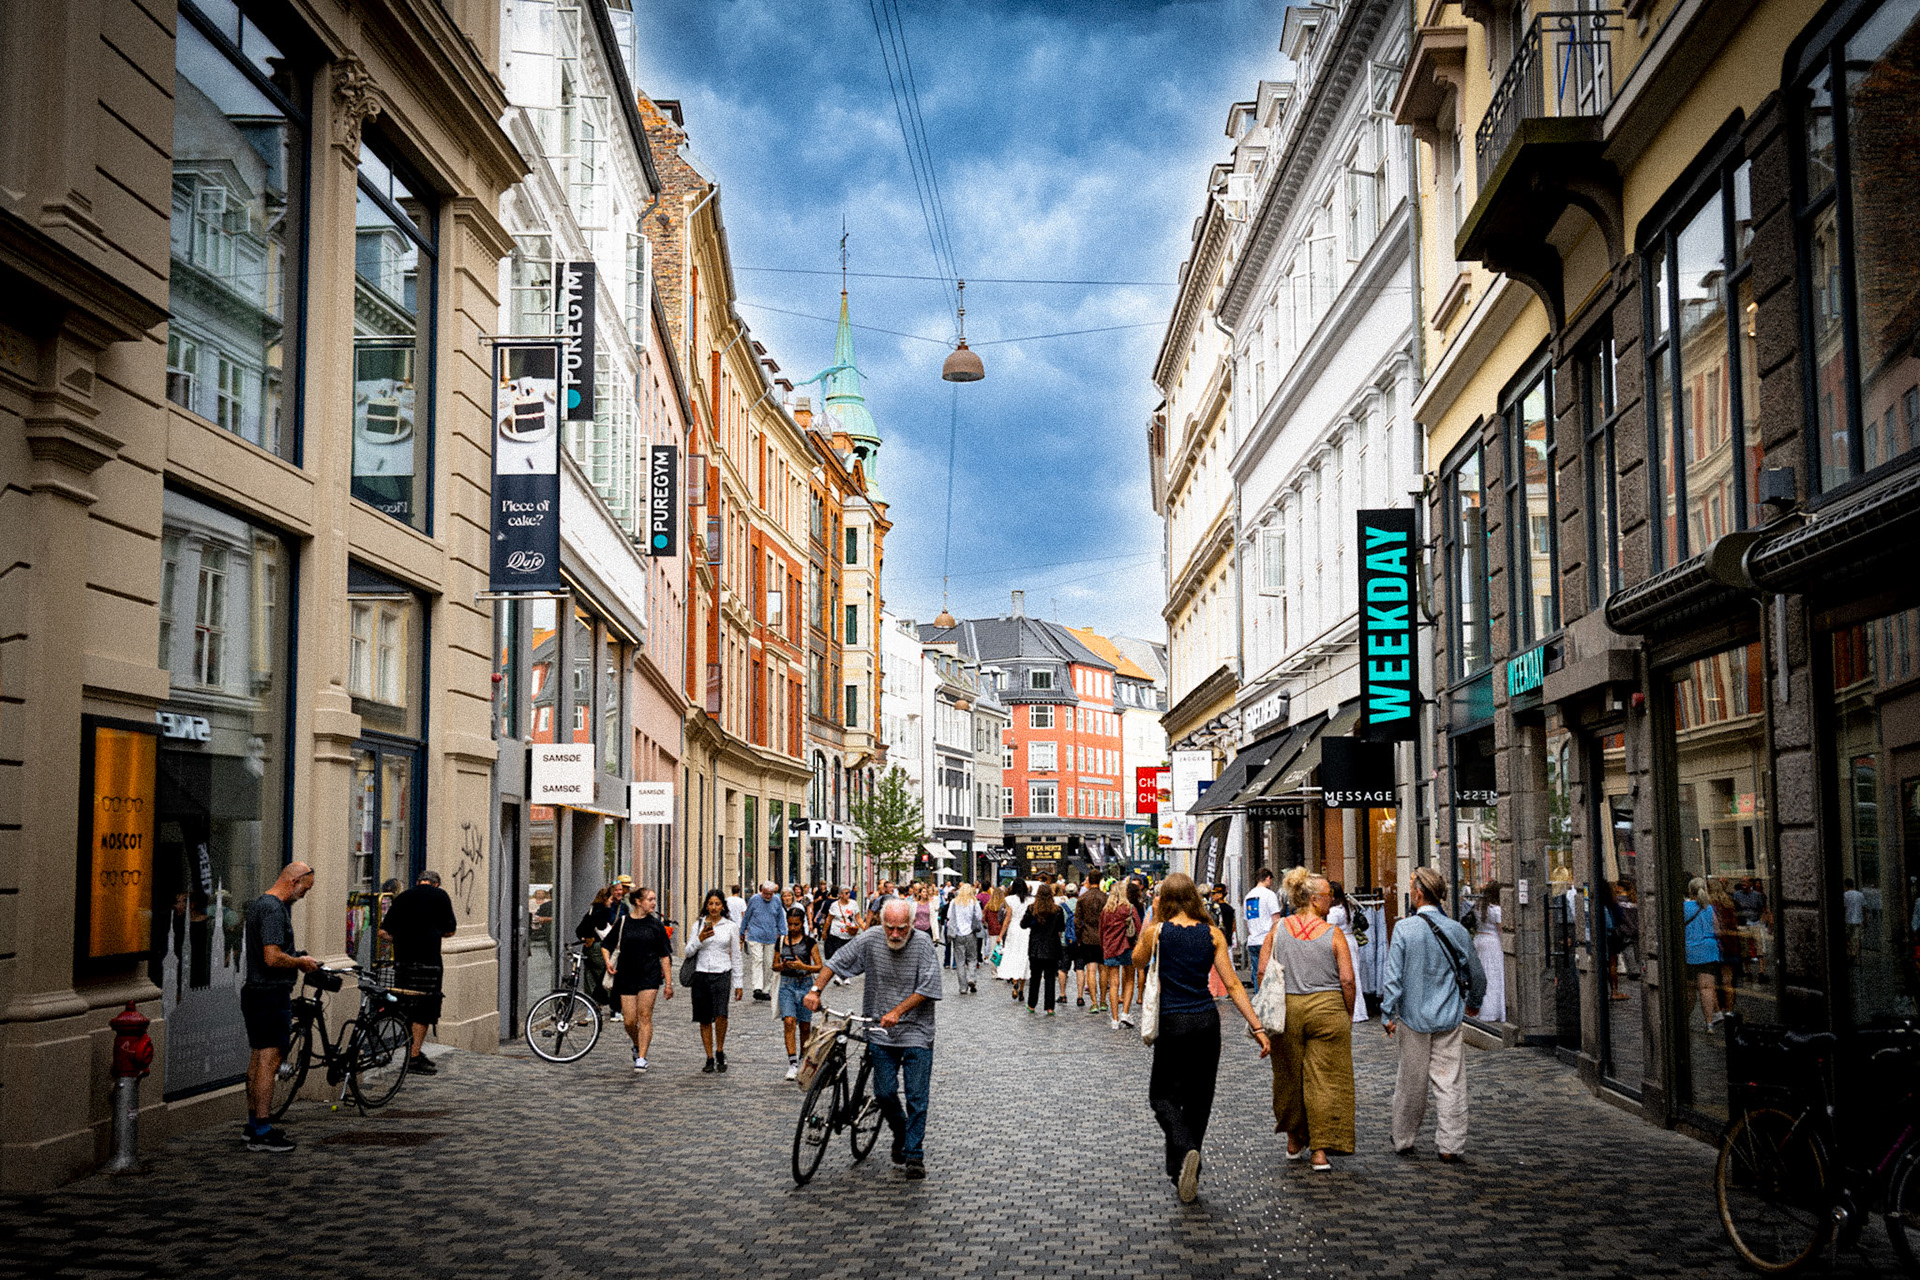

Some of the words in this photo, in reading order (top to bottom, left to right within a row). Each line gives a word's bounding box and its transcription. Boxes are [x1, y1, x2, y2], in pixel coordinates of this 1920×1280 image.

[565, 270, 583, 385] PUREGYM
[653, 452, 669, 532] PUREGYM
[502, 500, 535, 512] Piece
[536, 500, 550, 511] of
[508, 514, 544, 526] cake?
[1365, 526, 1411, 724] WEEKDAY
[1507, 645, 1544, 697] WEEKDAY
[542, 754, 581, 762] SAMSØE
[542, 784, 581, 793] SAMSØE
[1139, 777, 1157, 788] CH
[1139, 792, 1158, 803] CH
[1325, 791, 1392, 801] MESSAGE
[1249, 807, 1302, 816] MESSAGE
[101, 833, 142, 850] MOSCOT
